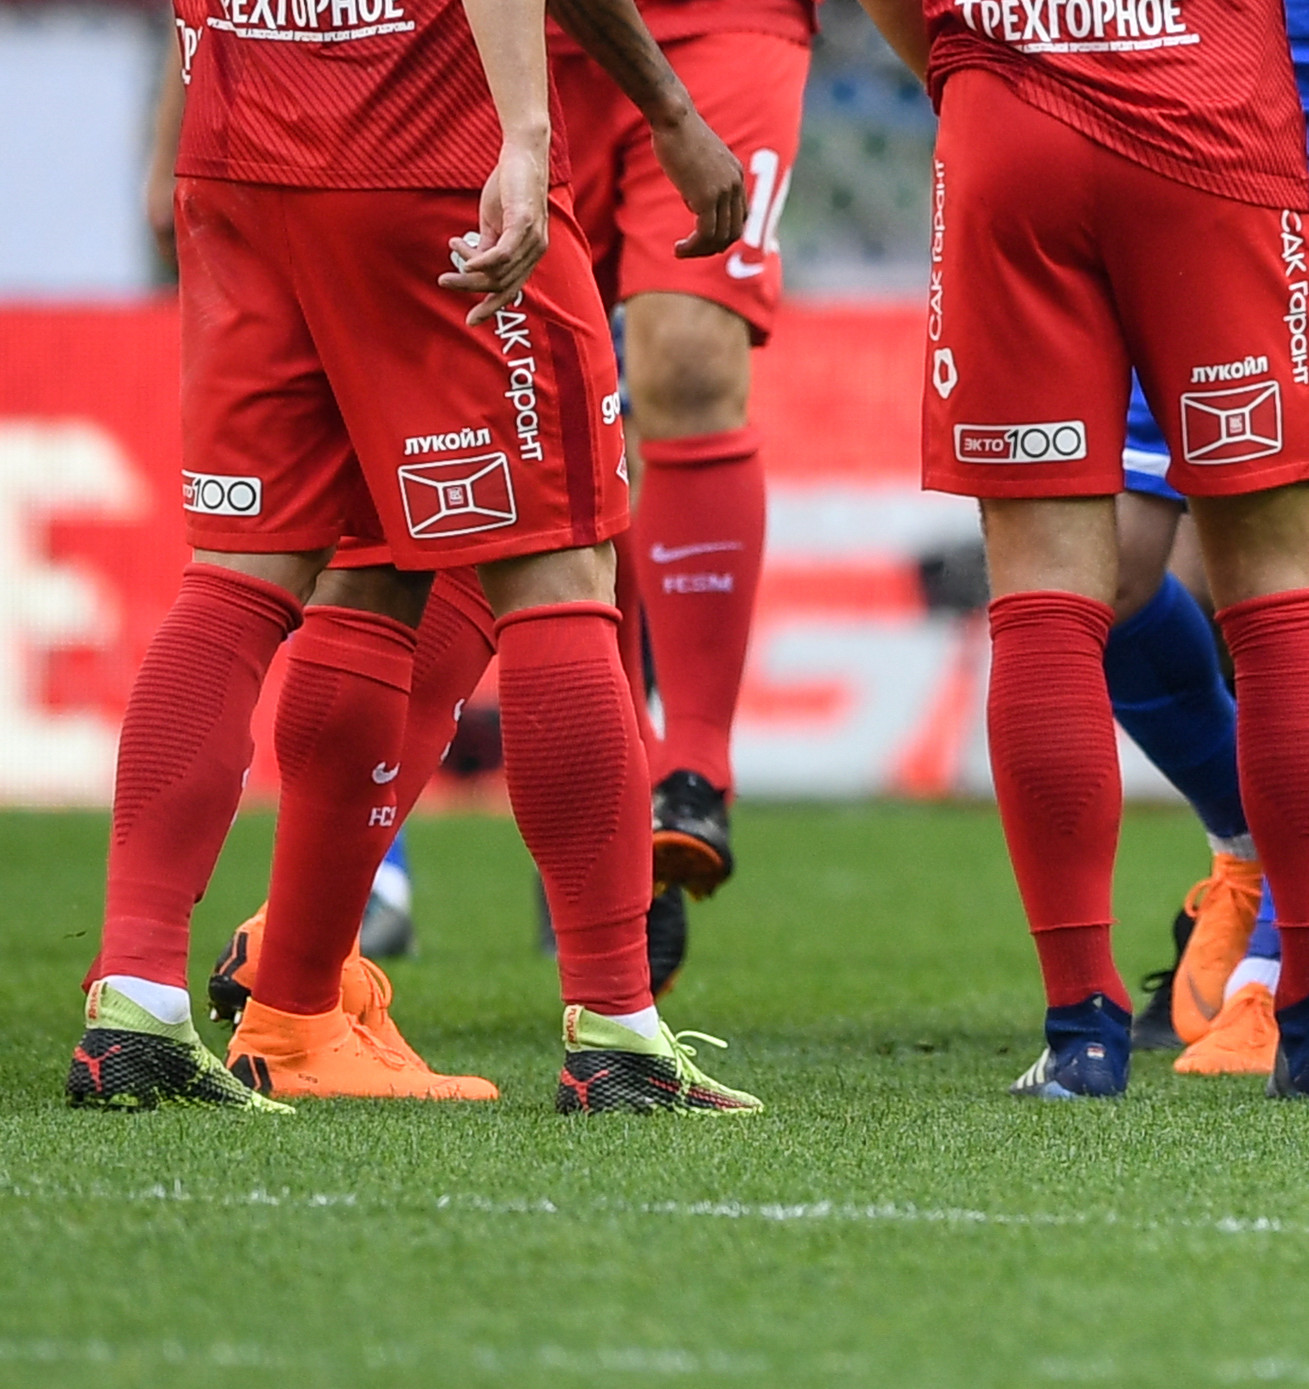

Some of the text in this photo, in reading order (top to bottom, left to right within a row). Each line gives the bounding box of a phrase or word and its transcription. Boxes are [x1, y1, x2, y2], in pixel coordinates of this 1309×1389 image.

[1190, 355, 1269, 384] ЛУКОЙЛ
[504, 356, 543, 462] Гарант
[404, 427, 492, 455] ЛУКОЙЛ
